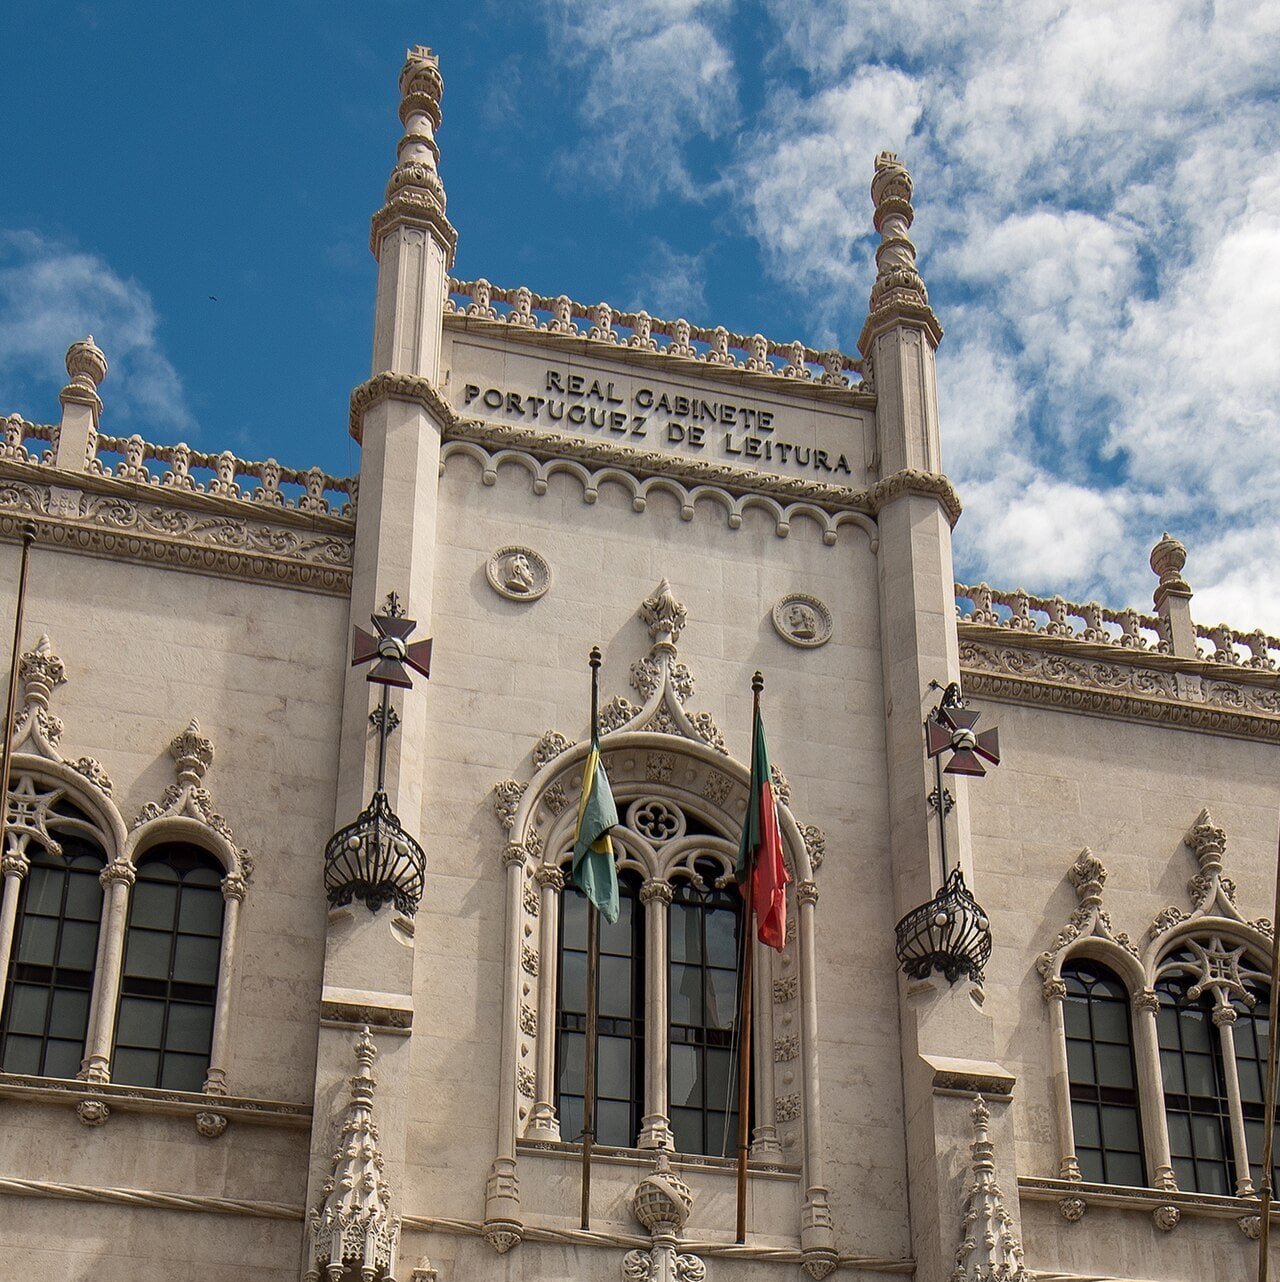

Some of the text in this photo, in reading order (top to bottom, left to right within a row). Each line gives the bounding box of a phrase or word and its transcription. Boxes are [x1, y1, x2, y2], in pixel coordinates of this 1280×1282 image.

[464, 384, 852, 474] PORTUGUEZ DE LEITURA
[546, 370, 775, 432] REAL GABINETE
